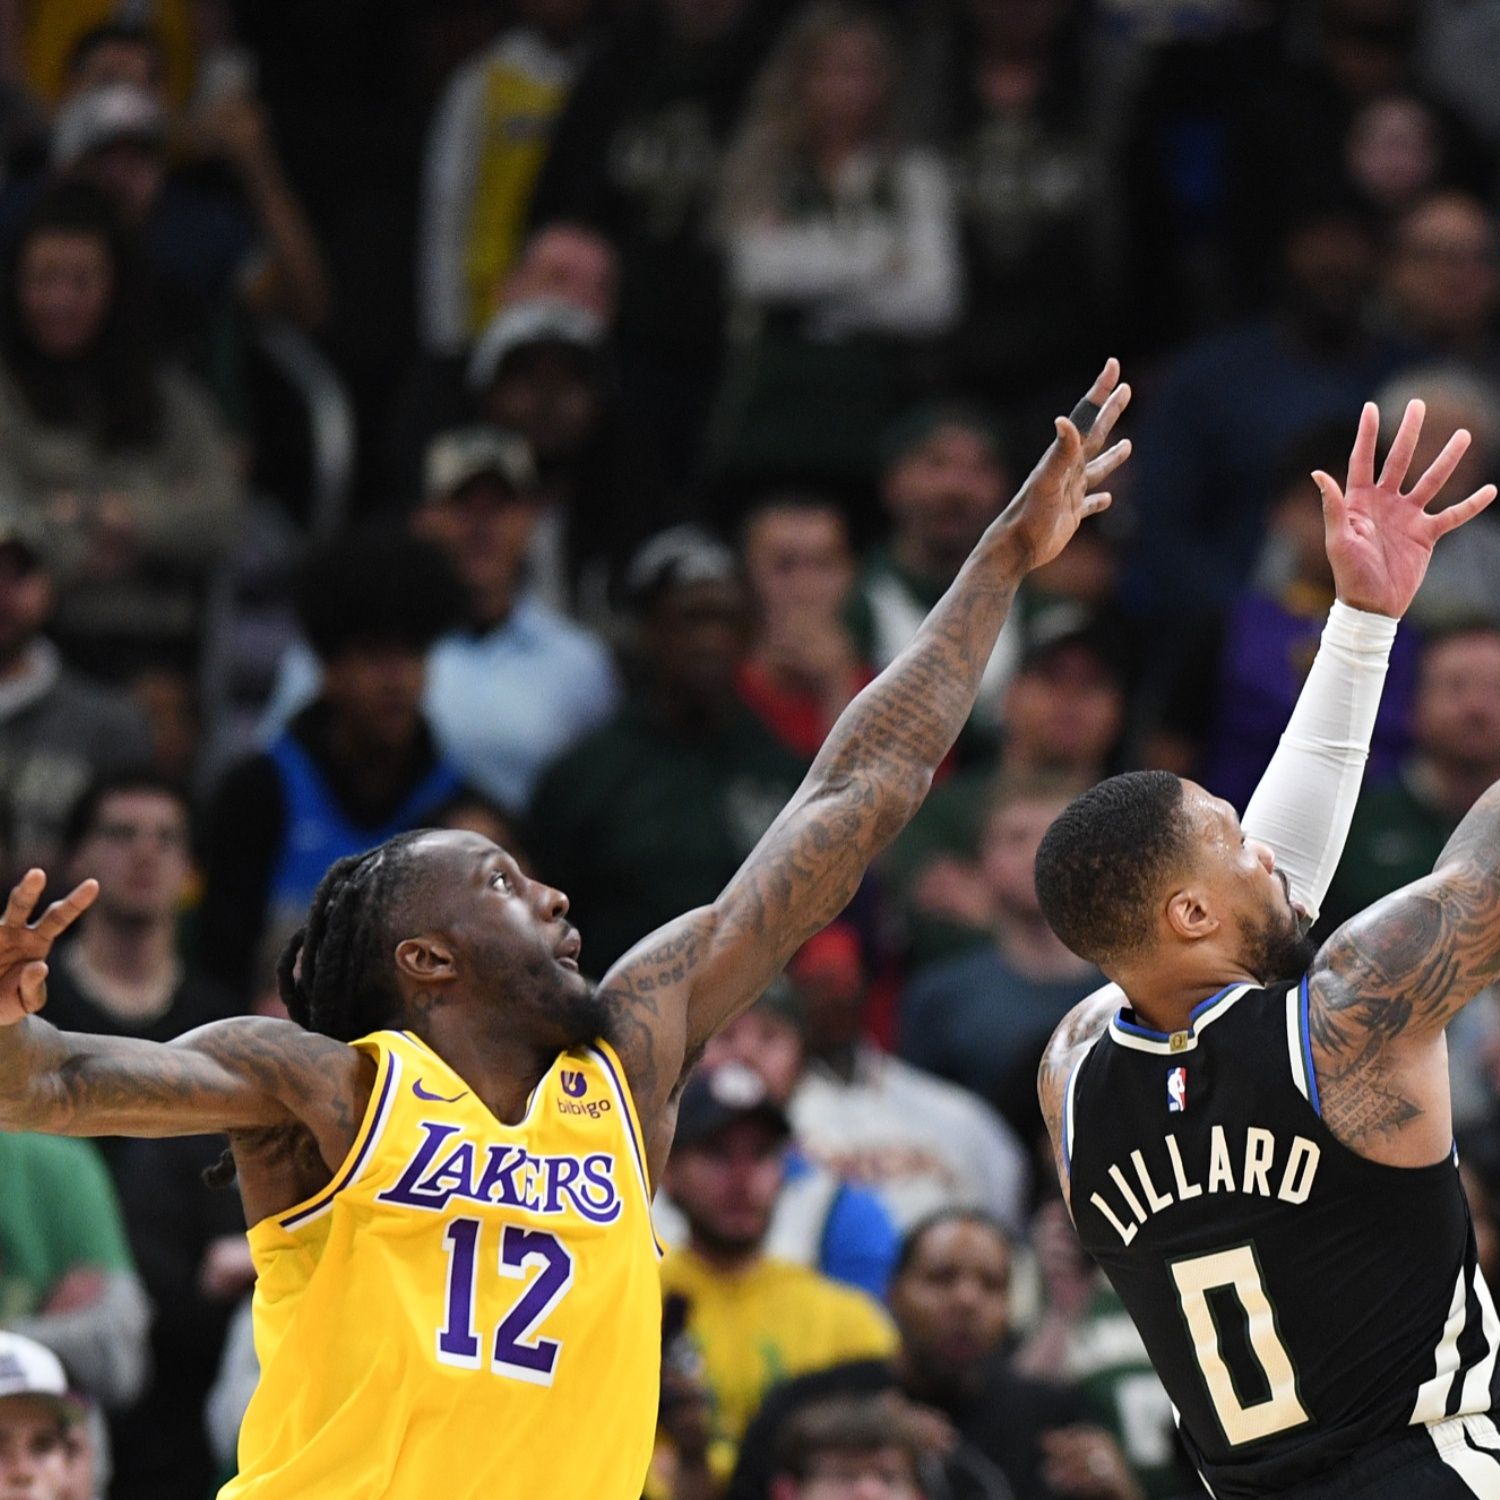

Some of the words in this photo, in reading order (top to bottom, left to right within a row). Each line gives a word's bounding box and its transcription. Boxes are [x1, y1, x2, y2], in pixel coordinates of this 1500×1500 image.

[557, 1097, 611, 1119] bibigo
[376, 1121, 623, 1224] LAKERS
[1090, 1125, 1321, 1247] LILLARD
[436, 1215, 576, 1388] 12
[1167, 1240, 1316, 1447] 0
